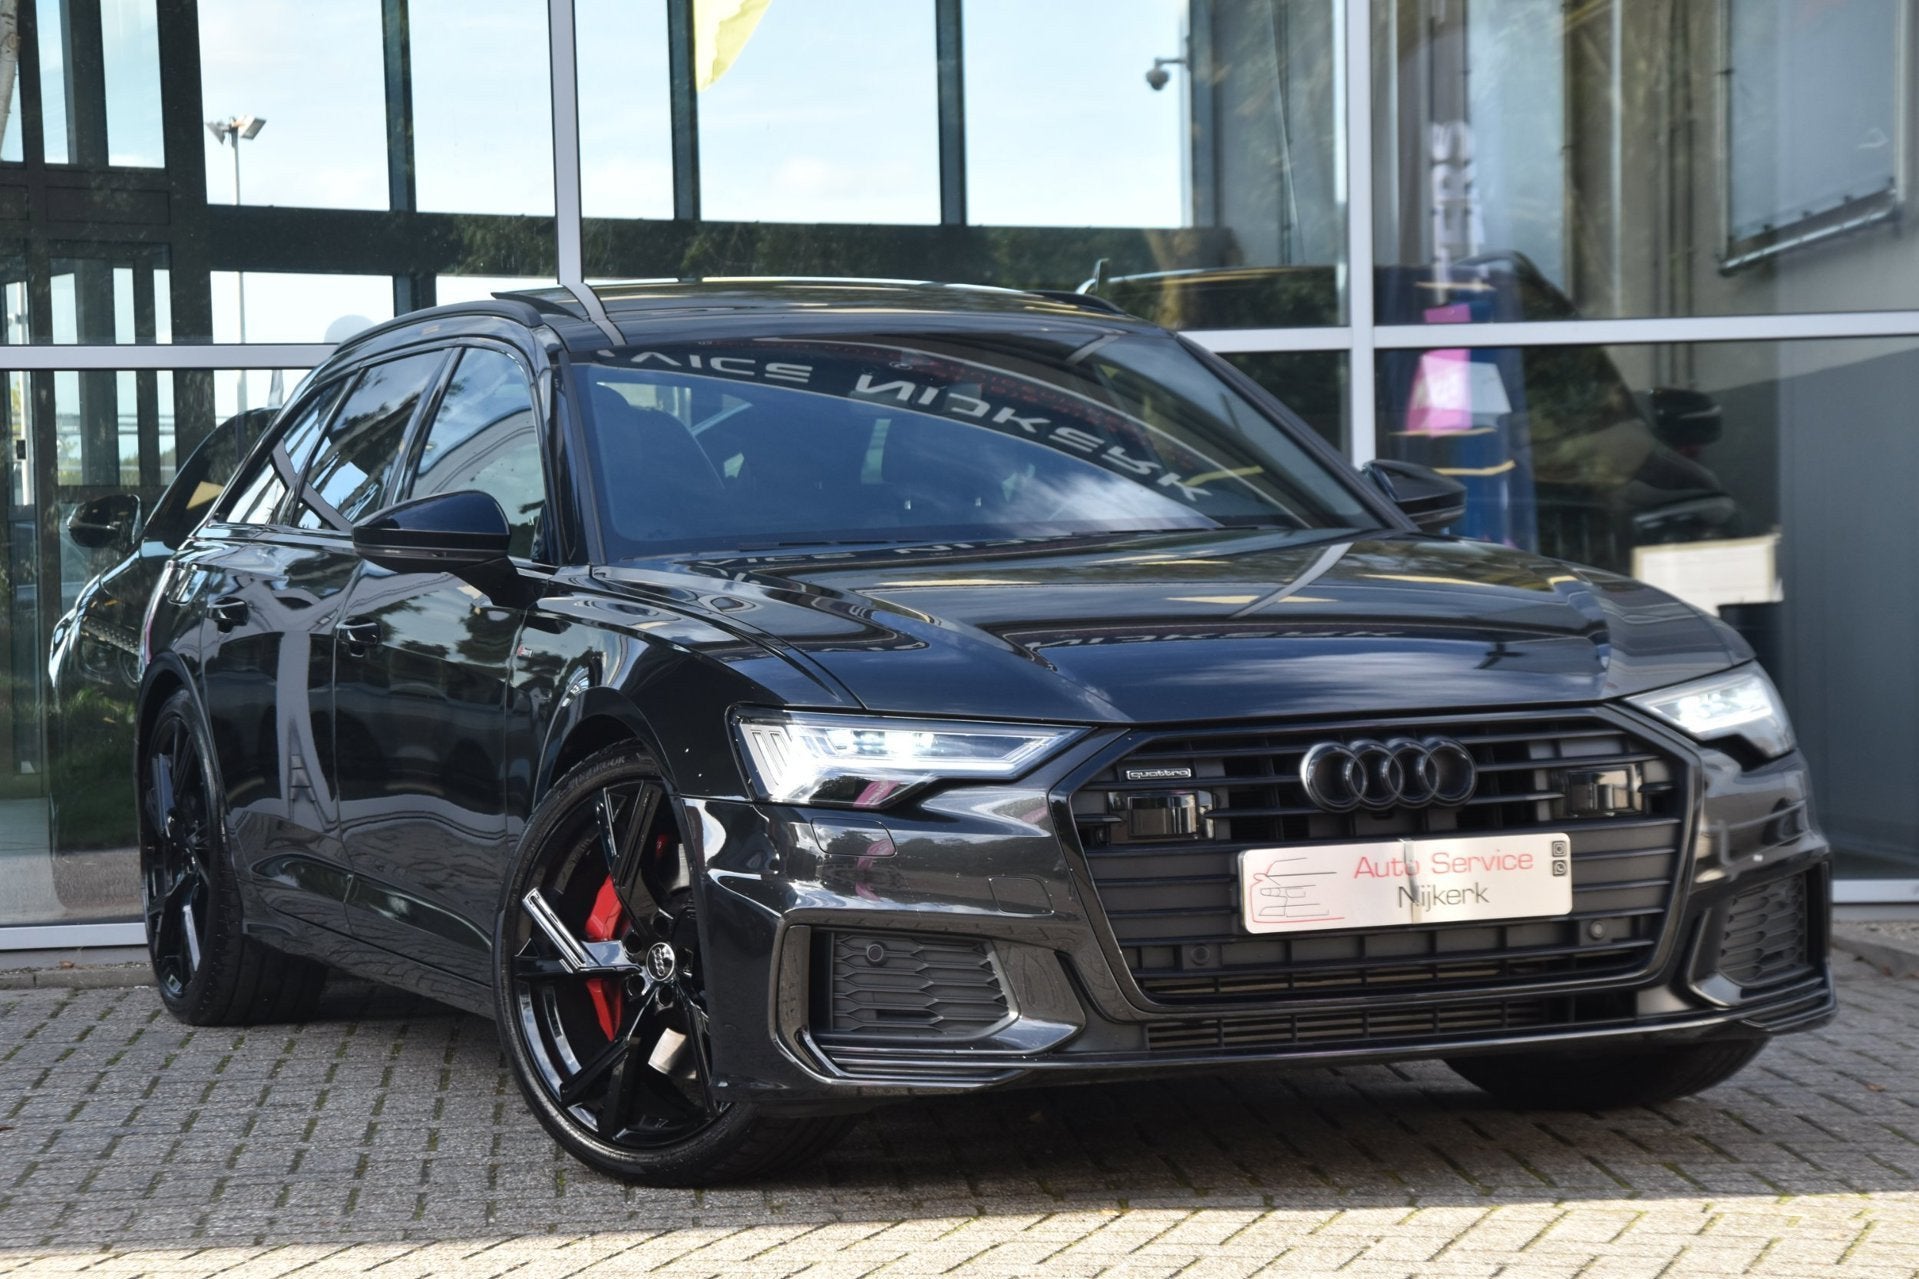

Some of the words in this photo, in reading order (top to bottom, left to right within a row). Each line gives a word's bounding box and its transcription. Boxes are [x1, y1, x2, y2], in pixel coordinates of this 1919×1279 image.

[1129, 769, 1189, 779] quattro
[1354, 856, 1421, 879] Auto
[1431, 850, 1534, 875] Service
[1398, 883, 1491, 912] Nijkerk
